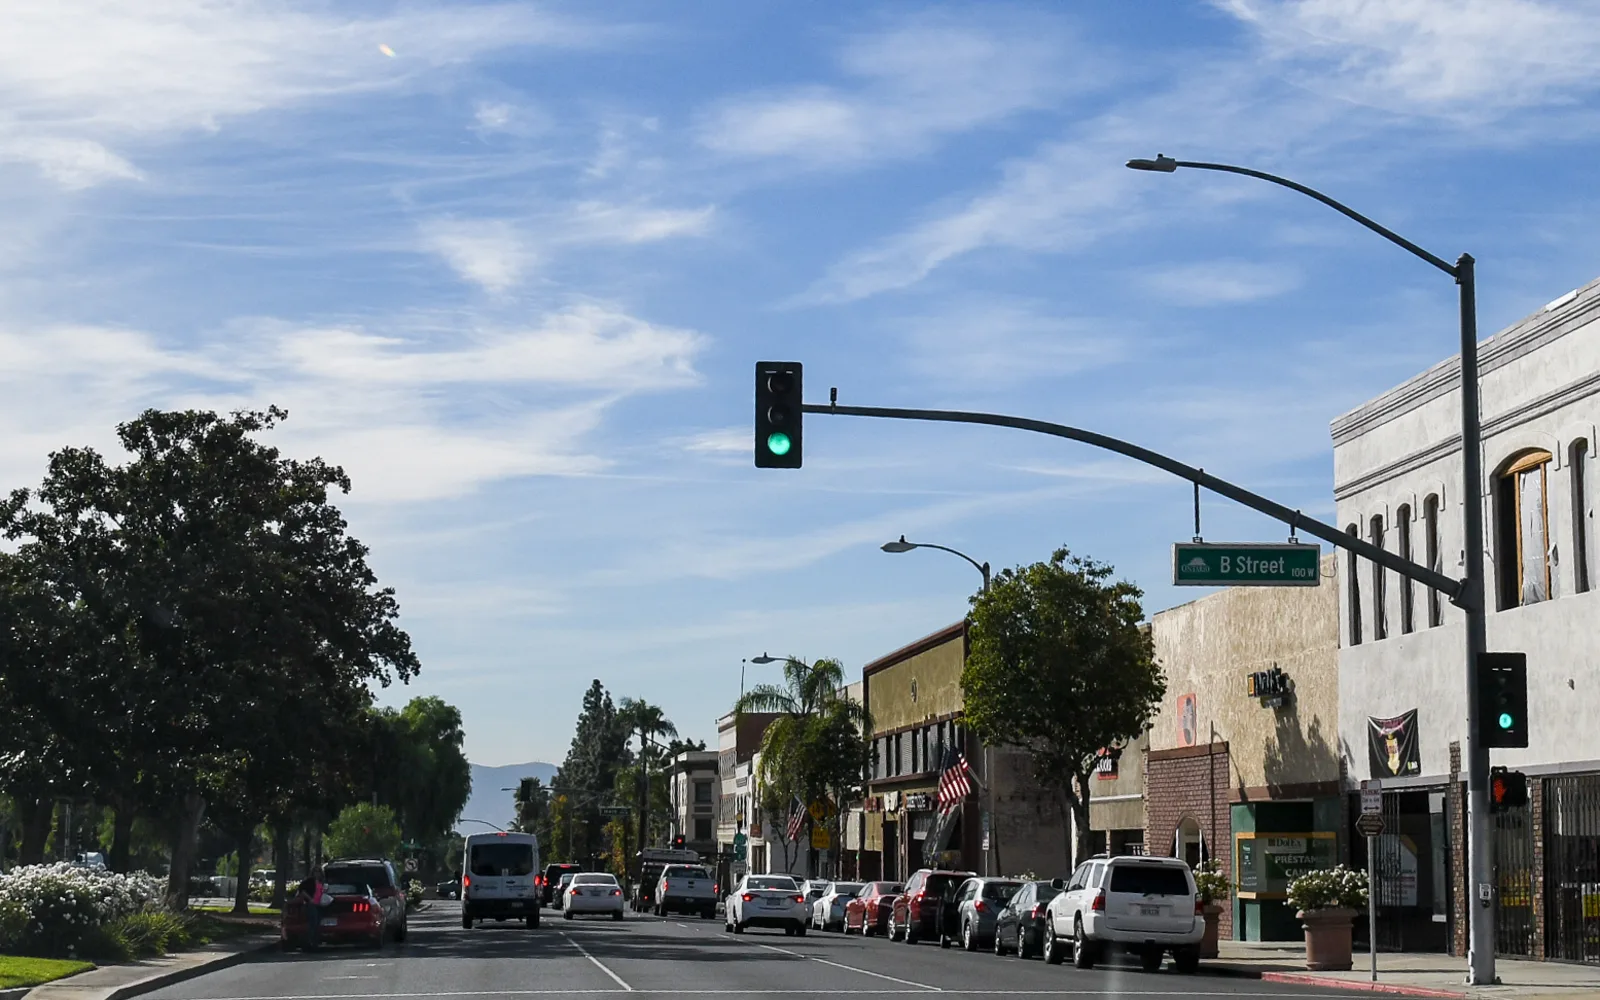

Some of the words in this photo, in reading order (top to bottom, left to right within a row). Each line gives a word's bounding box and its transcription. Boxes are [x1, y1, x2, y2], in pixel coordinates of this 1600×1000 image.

[1220, 556, 1231, 573] B
[1236, 556, 1285, 574] Street
[1291, 567, 1306, 577] 100
[1308, 567, 1315, 577] W
